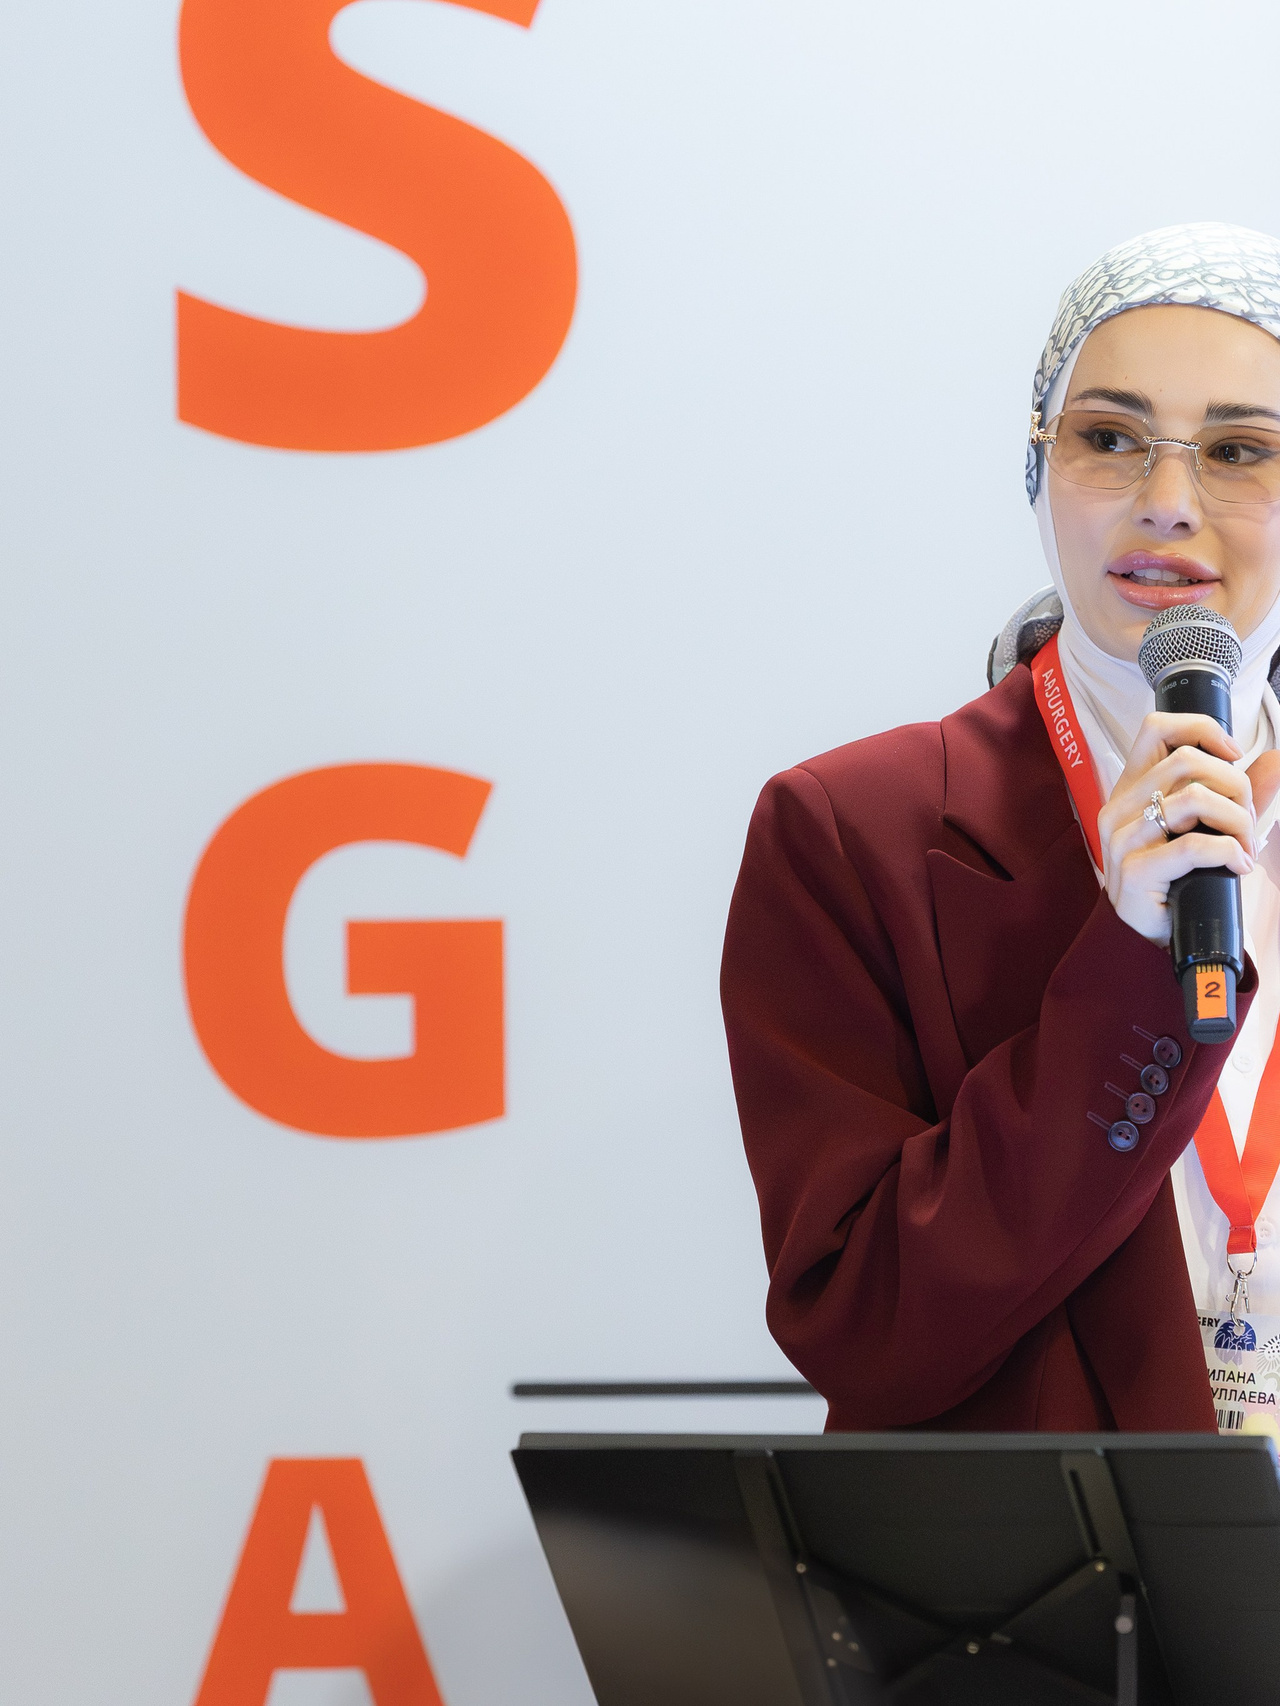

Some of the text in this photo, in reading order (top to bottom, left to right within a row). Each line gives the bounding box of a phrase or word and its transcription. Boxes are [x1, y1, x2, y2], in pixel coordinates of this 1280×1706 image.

[1042, 668, 1084, 769] AASURGERY
[183, 761, 507, 1140] G
[1204, 981, 1221, 999] 2
